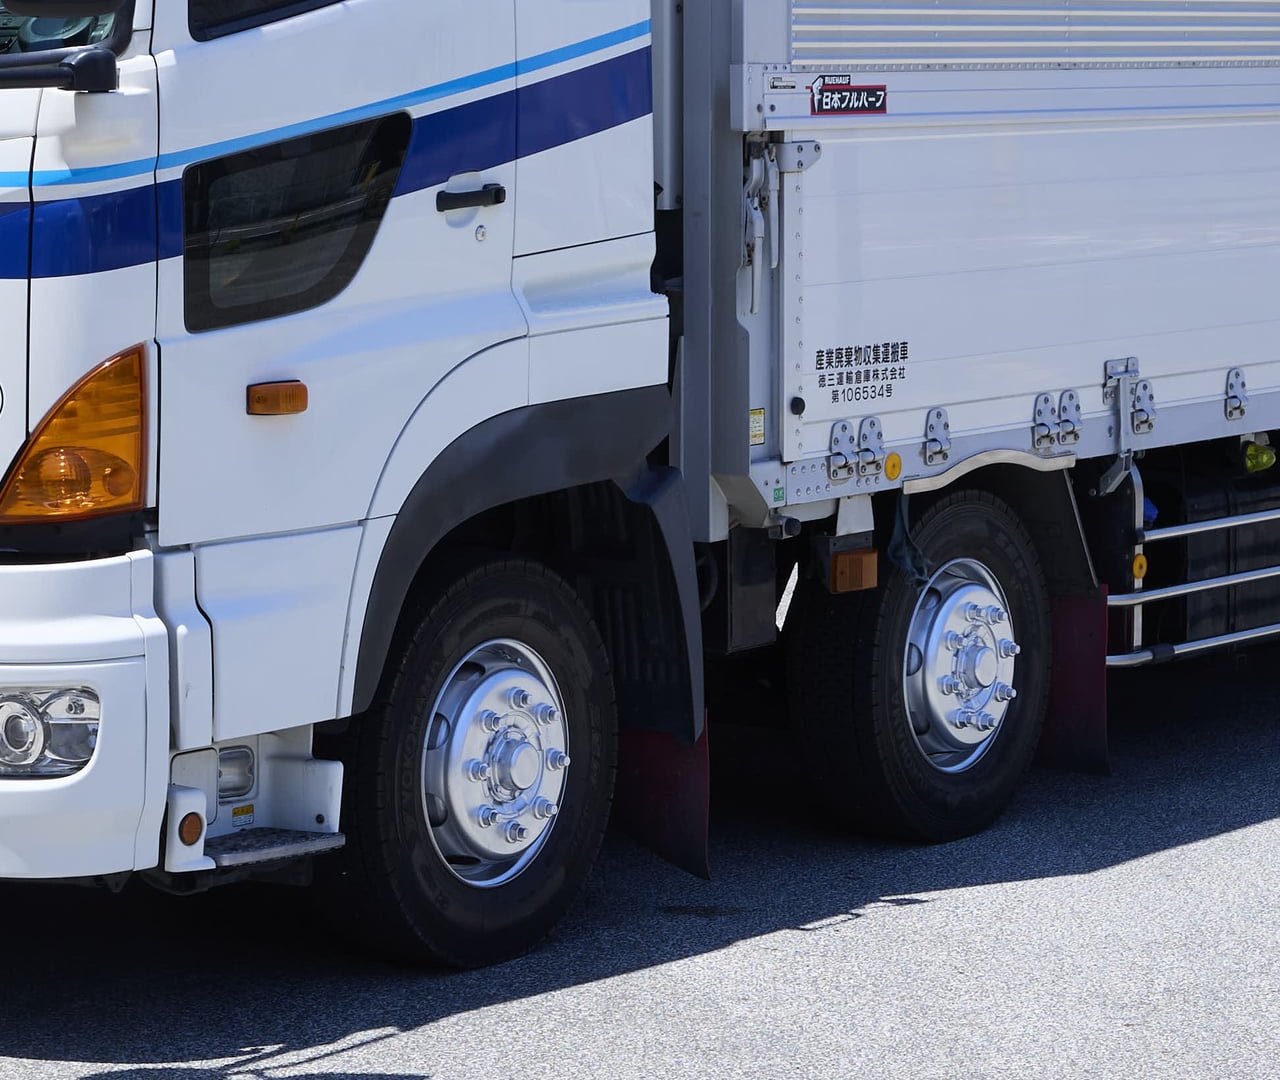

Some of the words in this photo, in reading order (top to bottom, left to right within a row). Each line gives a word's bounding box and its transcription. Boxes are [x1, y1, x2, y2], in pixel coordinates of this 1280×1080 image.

[822, 90, 885, 110] 日本フルハーフ
[815, 341, 909, 371] 産業廃棄物収集運搬車
[831, 383, 894, 404] 第106534号
